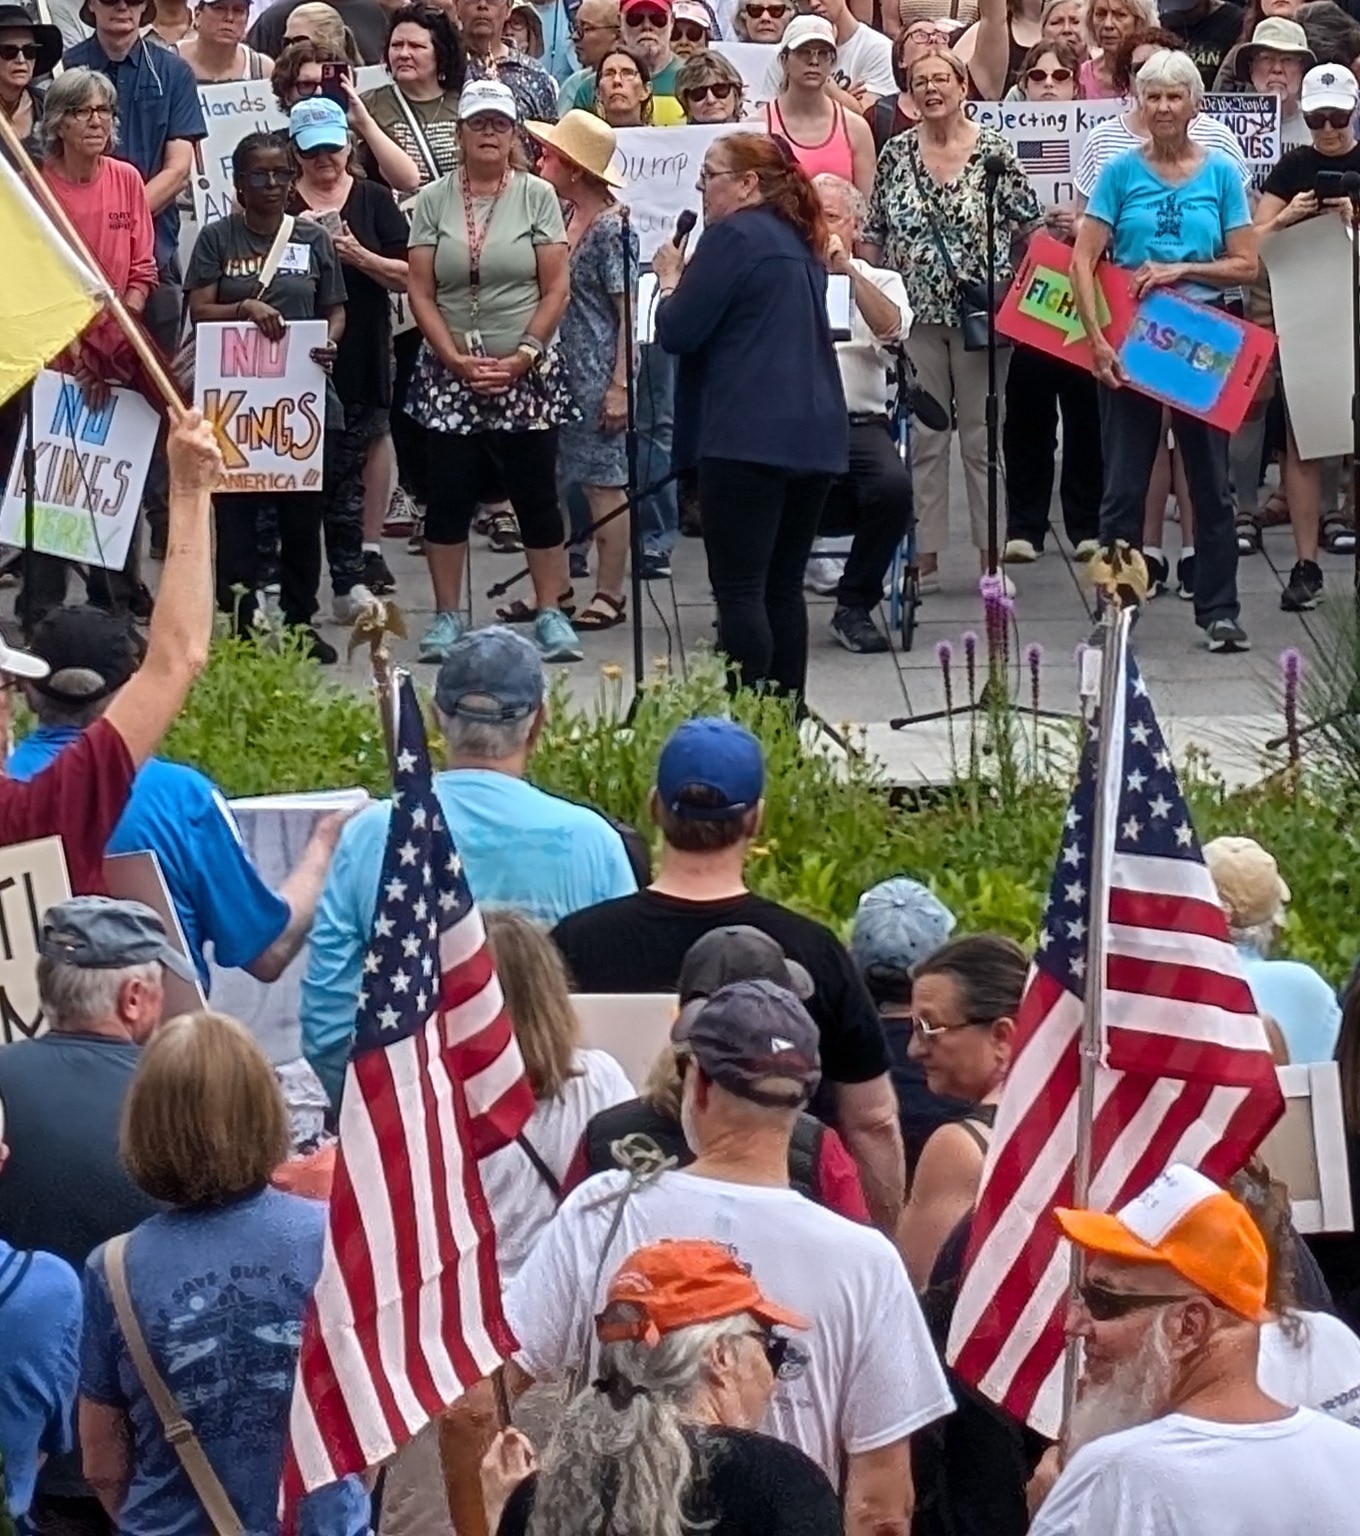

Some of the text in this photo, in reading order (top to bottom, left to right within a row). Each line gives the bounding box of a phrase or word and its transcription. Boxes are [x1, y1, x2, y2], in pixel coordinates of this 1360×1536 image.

[1231, 115, 1248, 135] NO
[221, 327, 291, 378] NO
[203, 389, 321, 469] KINGS
[12, 441, 133, 517] KINGS
